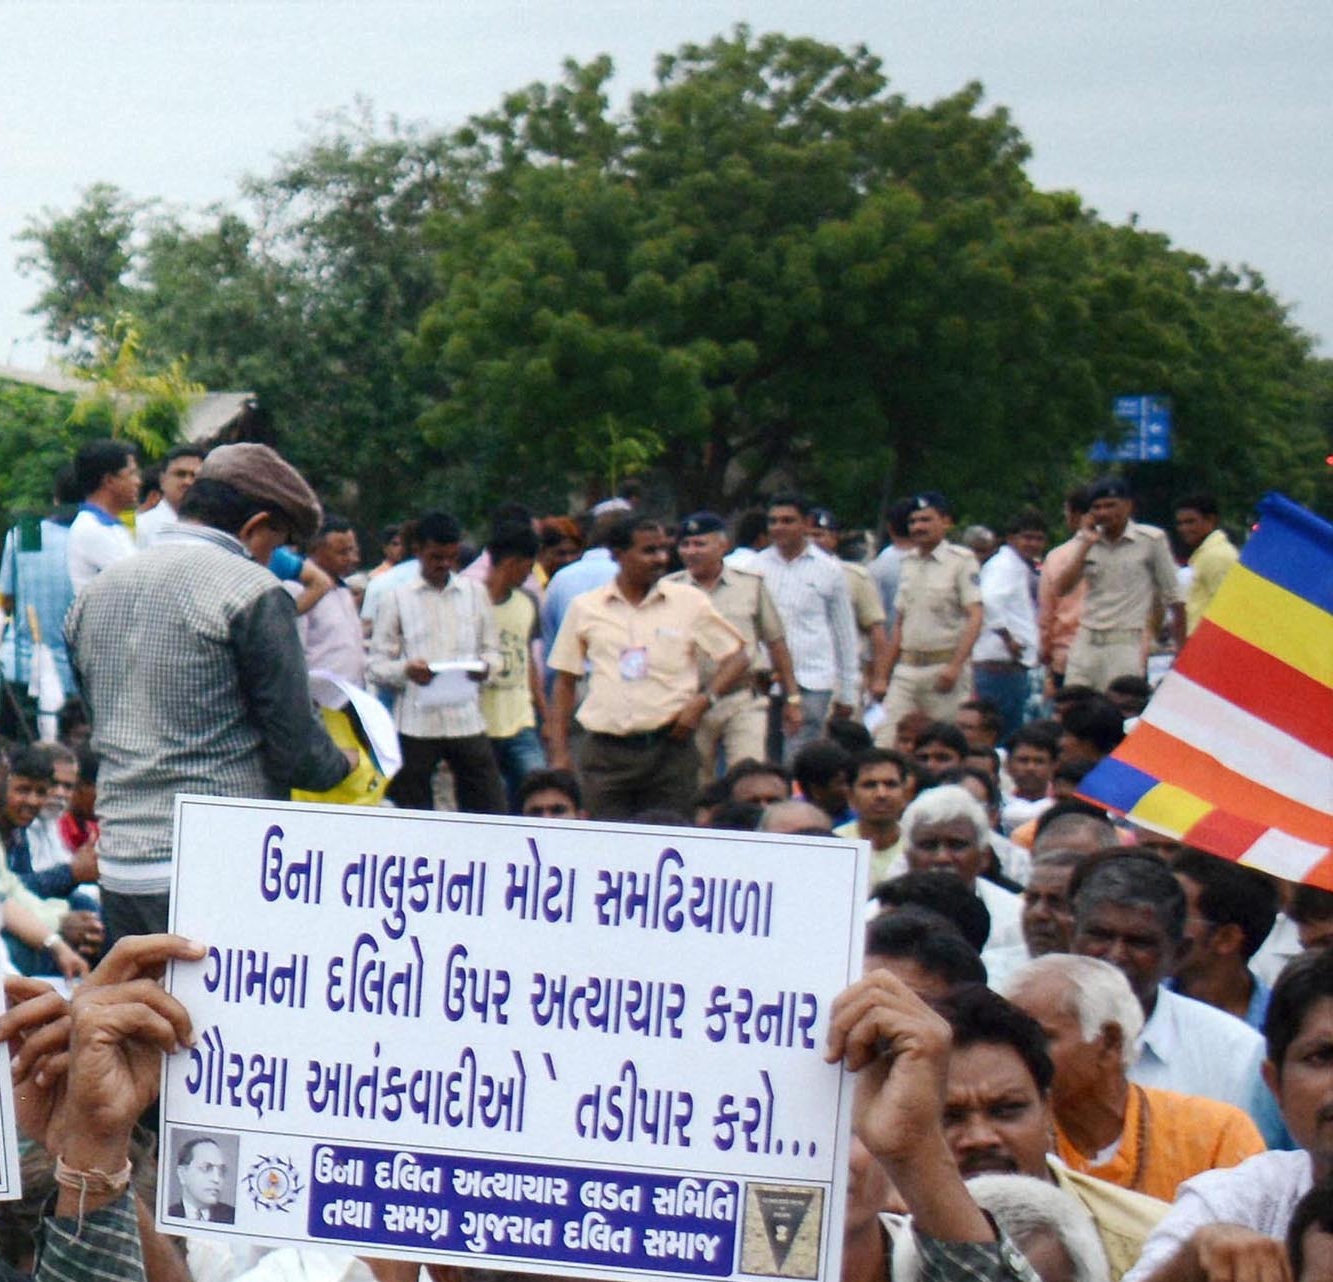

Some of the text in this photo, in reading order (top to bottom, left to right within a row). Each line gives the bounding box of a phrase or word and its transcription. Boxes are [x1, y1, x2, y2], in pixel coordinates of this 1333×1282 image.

[261, 825, 772, 940] ઉના તાલુકાના મોટા સમઢિયાળા
[204, 933, 817, 1049] ગામના દલિતો ઉપર અત્યાચાર કરનાર
[185, 1026, 693, 1147] ગૌરક્ષા તડીપાર
[315, 1147, 734, 1220] ઉના દલિત અત્યાચાર લડત સમિતિ
[323, 1200, 720, 1261] તથા સમગ્ર ગુજરાત દલિત સમાજ
